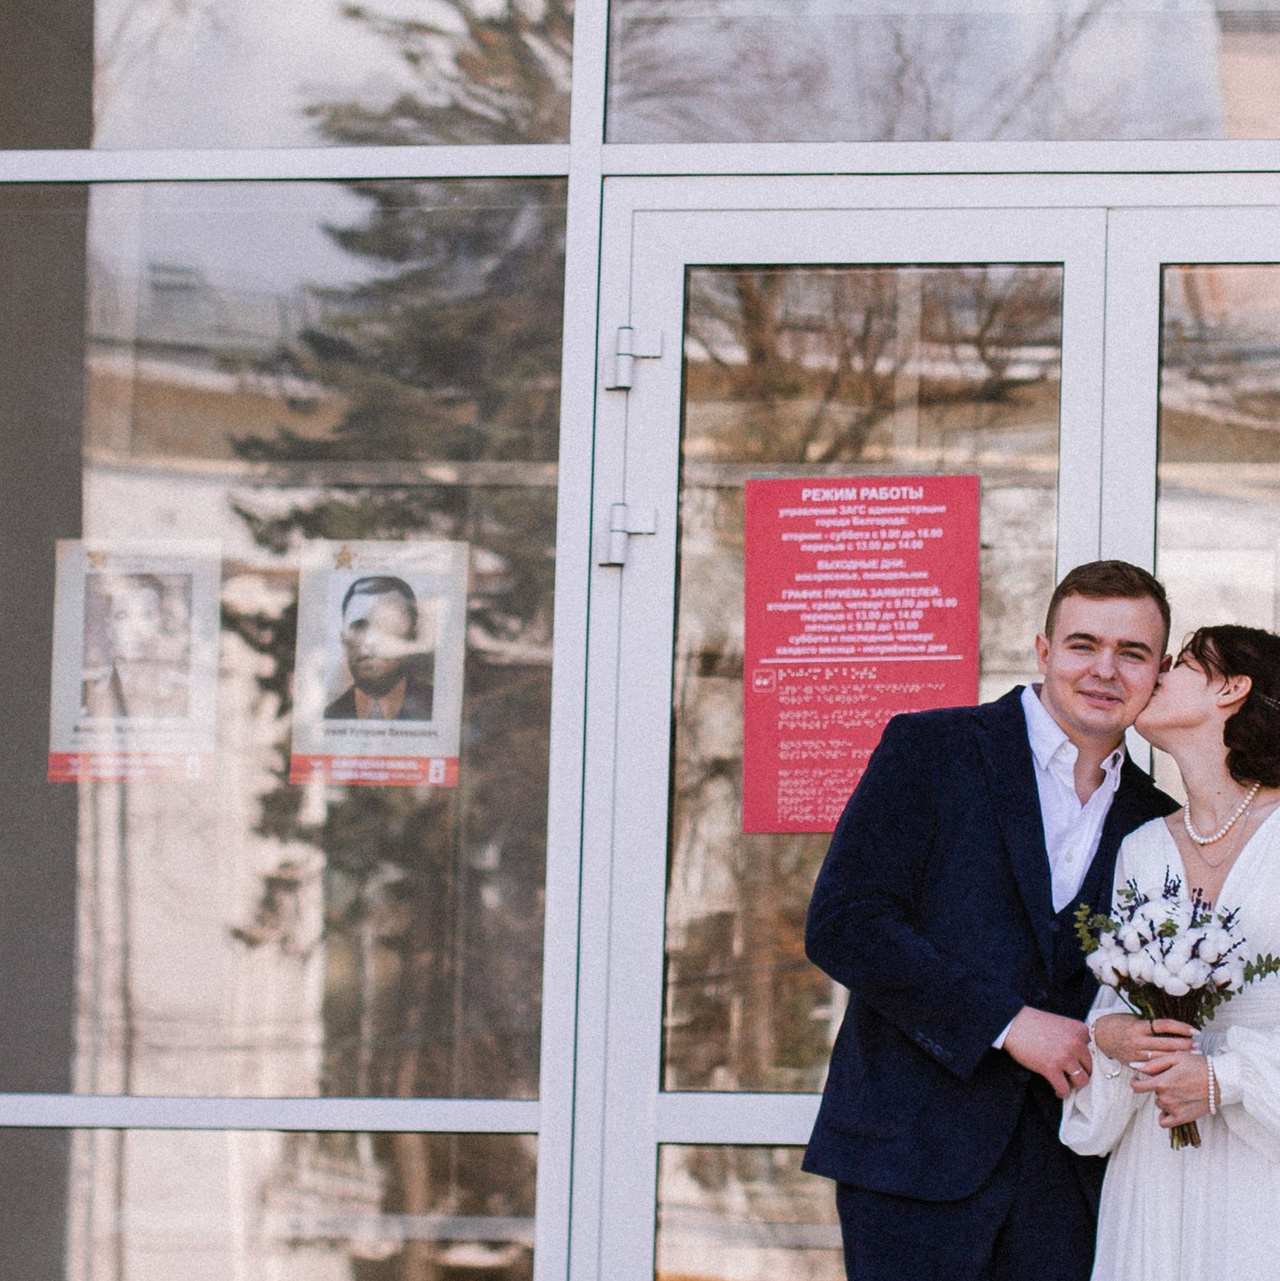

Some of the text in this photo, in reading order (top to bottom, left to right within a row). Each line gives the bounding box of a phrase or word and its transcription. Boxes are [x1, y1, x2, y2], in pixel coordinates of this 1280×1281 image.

[802, 487, 924, 502] РЕЖИМ РАБОТЫ
[839, 505, 866, 515] ЗАГС
[781, 589, 822, 599] ГРАФИК
